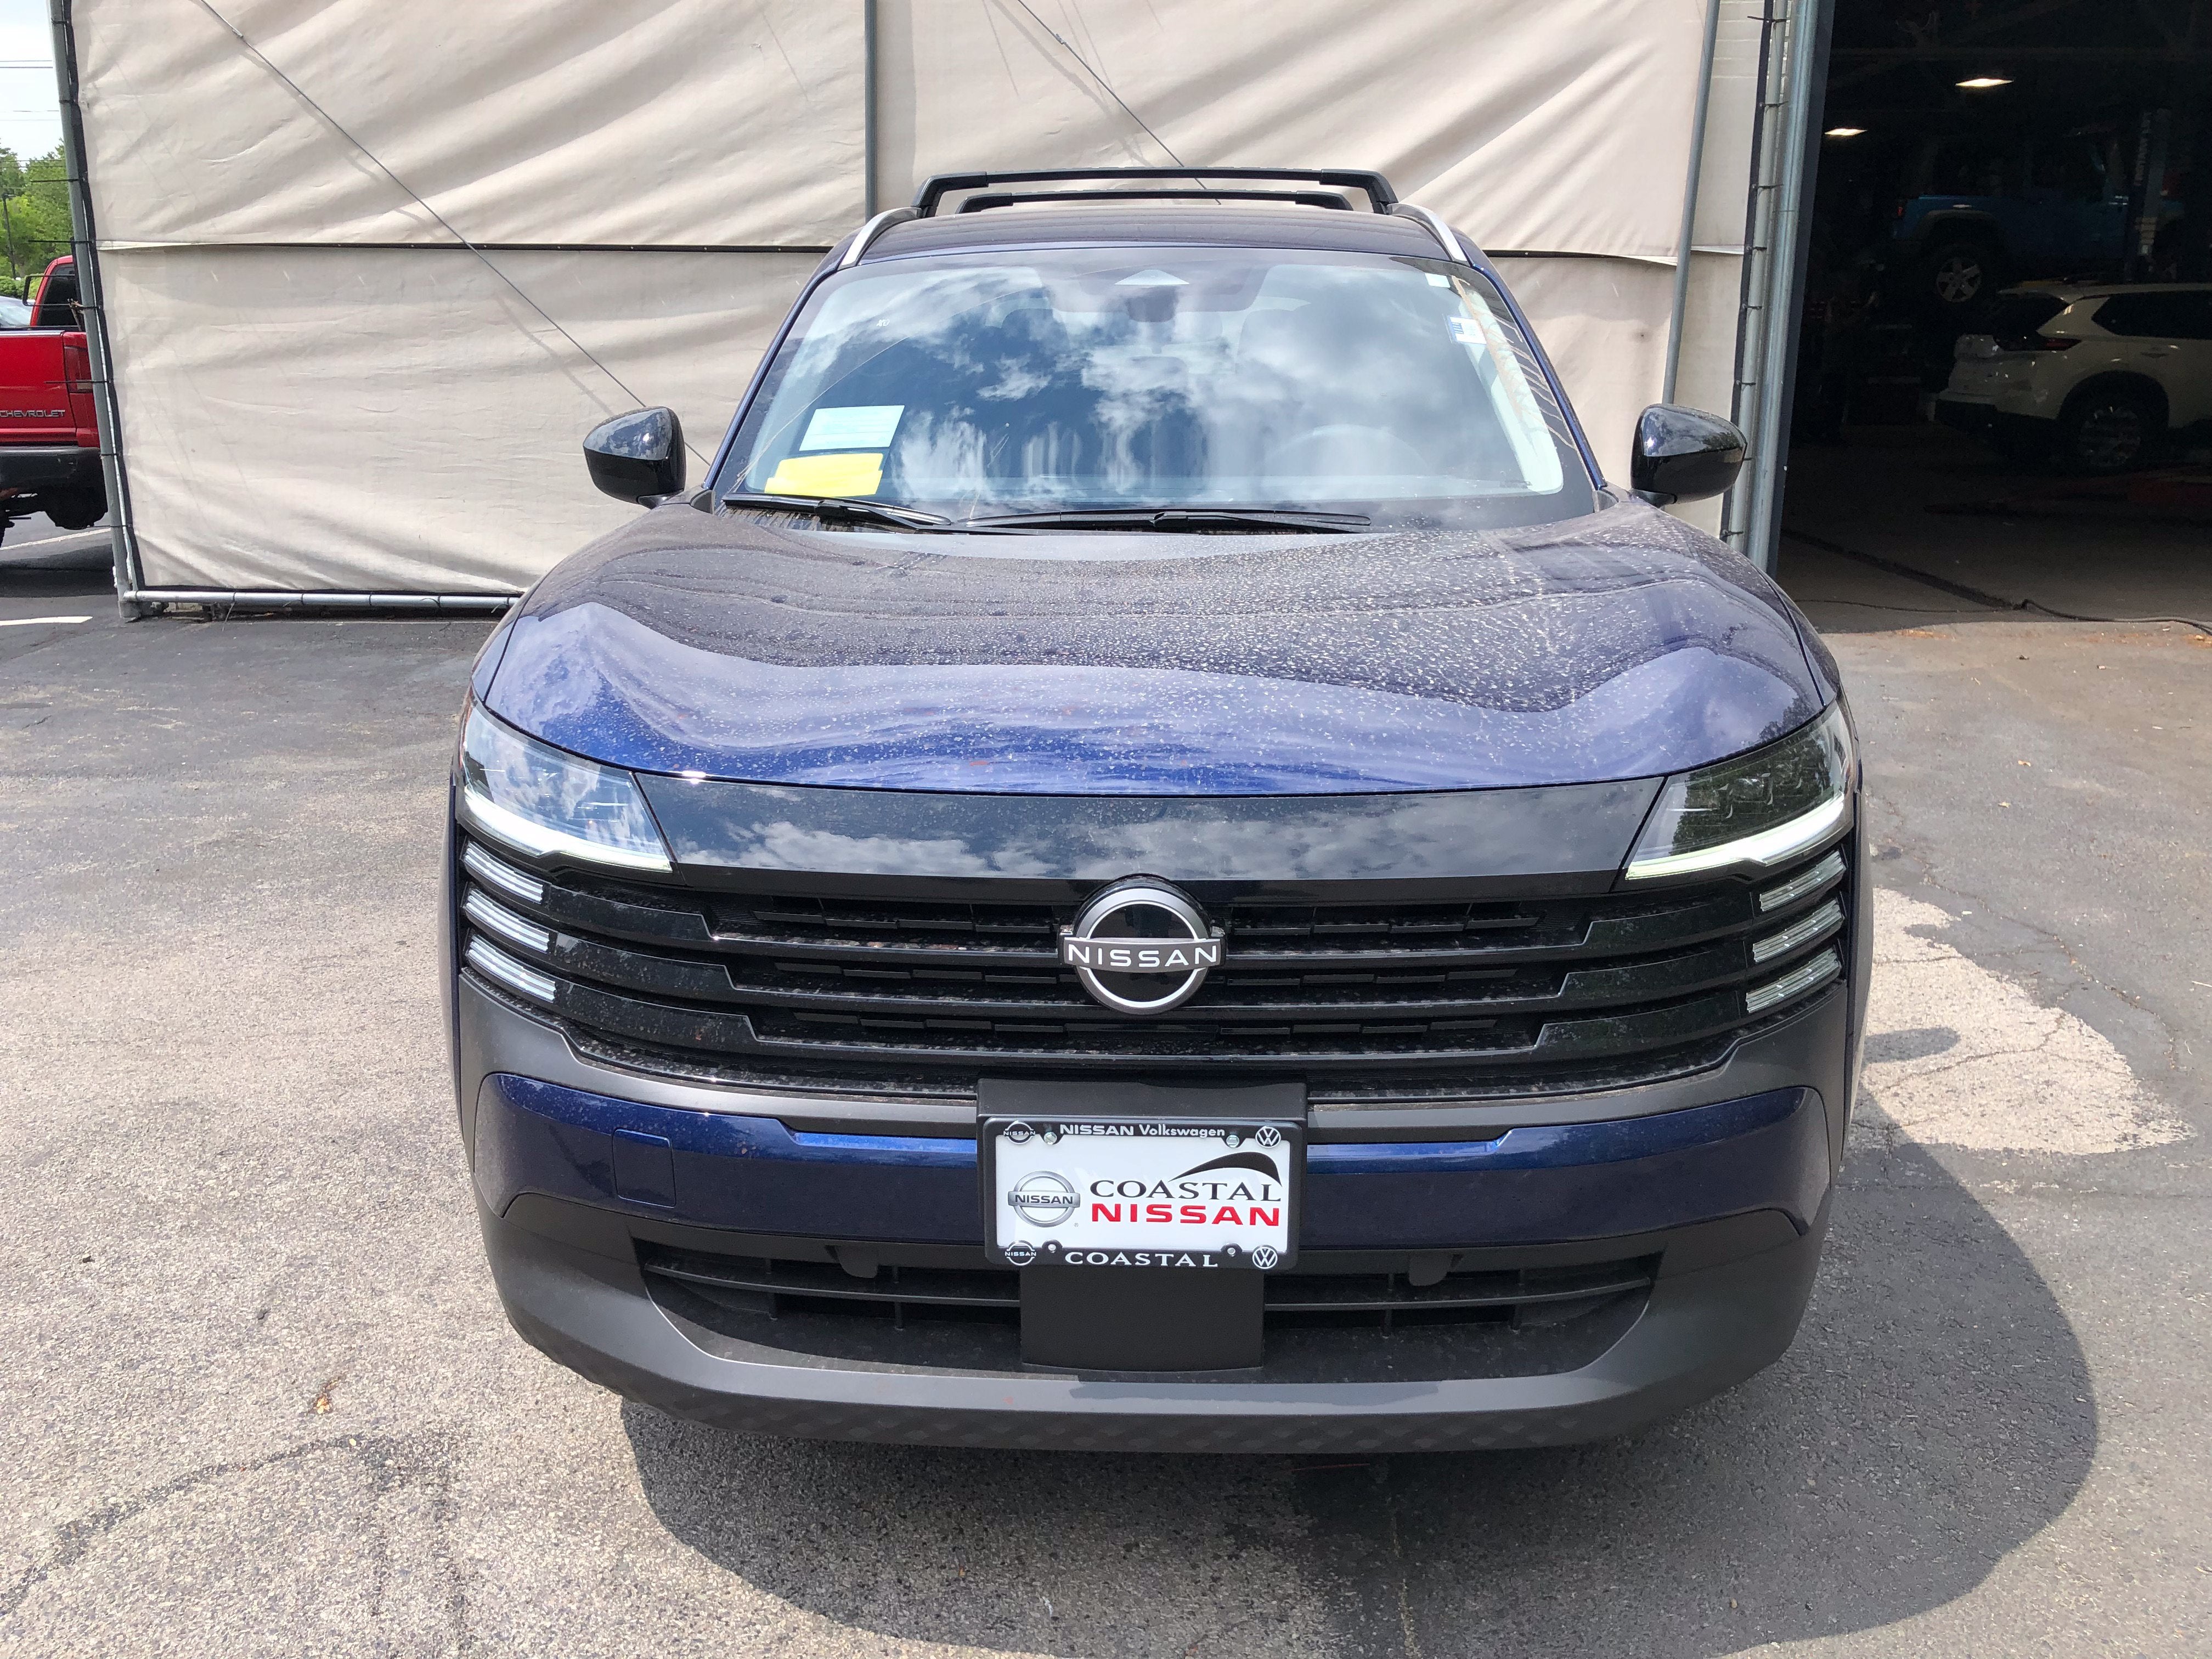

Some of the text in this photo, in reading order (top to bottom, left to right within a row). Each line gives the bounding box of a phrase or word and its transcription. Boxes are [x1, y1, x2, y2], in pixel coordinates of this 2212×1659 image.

[1068, 944, 1216, 967] NISSAN
[1060, 1124, 1225, 1138] NISSAN Volkswagen
[1256, 1126, 1280, 1147] VW
[1015, 1194, 1073, 1204] NISSAN
[1090, 1180, 1281, 1201] COASTAL
[1092, 1203, 1279, 1226] NISSAN
[1065, 1251, 1218, 1267] COASTAL
[1253, 1247, 1277, 1268] VW
